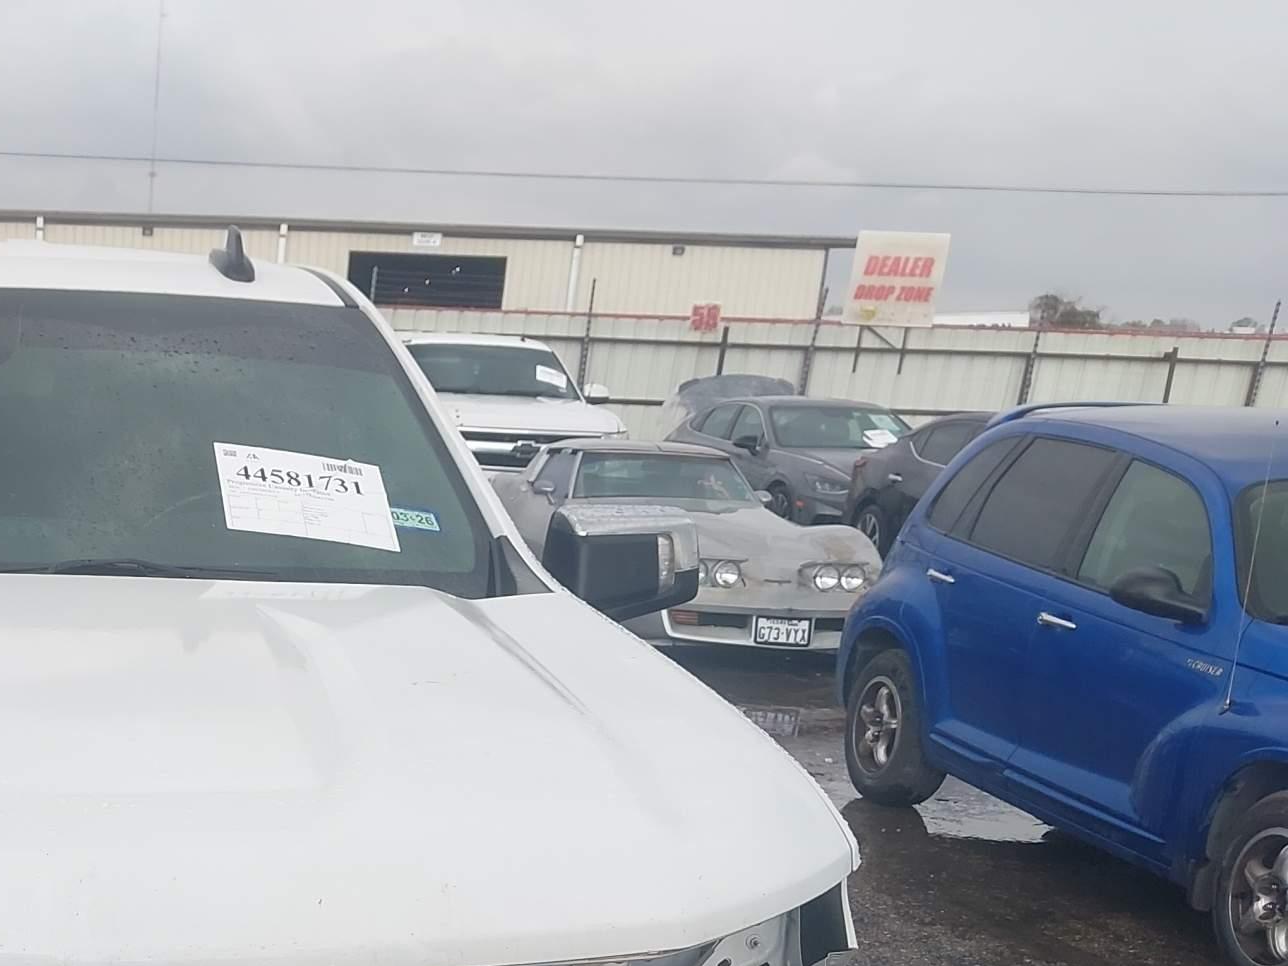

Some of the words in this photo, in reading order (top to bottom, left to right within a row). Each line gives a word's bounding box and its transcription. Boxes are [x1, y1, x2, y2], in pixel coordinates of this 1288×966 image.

[863, 255, 935, 278] DEALER
[853, 284, 896, 301] DROP
[895, 285, 934, 302] ZONE
[235, 465, 364, 496] 44581731
[391, 511, 434, 525] 03-26
